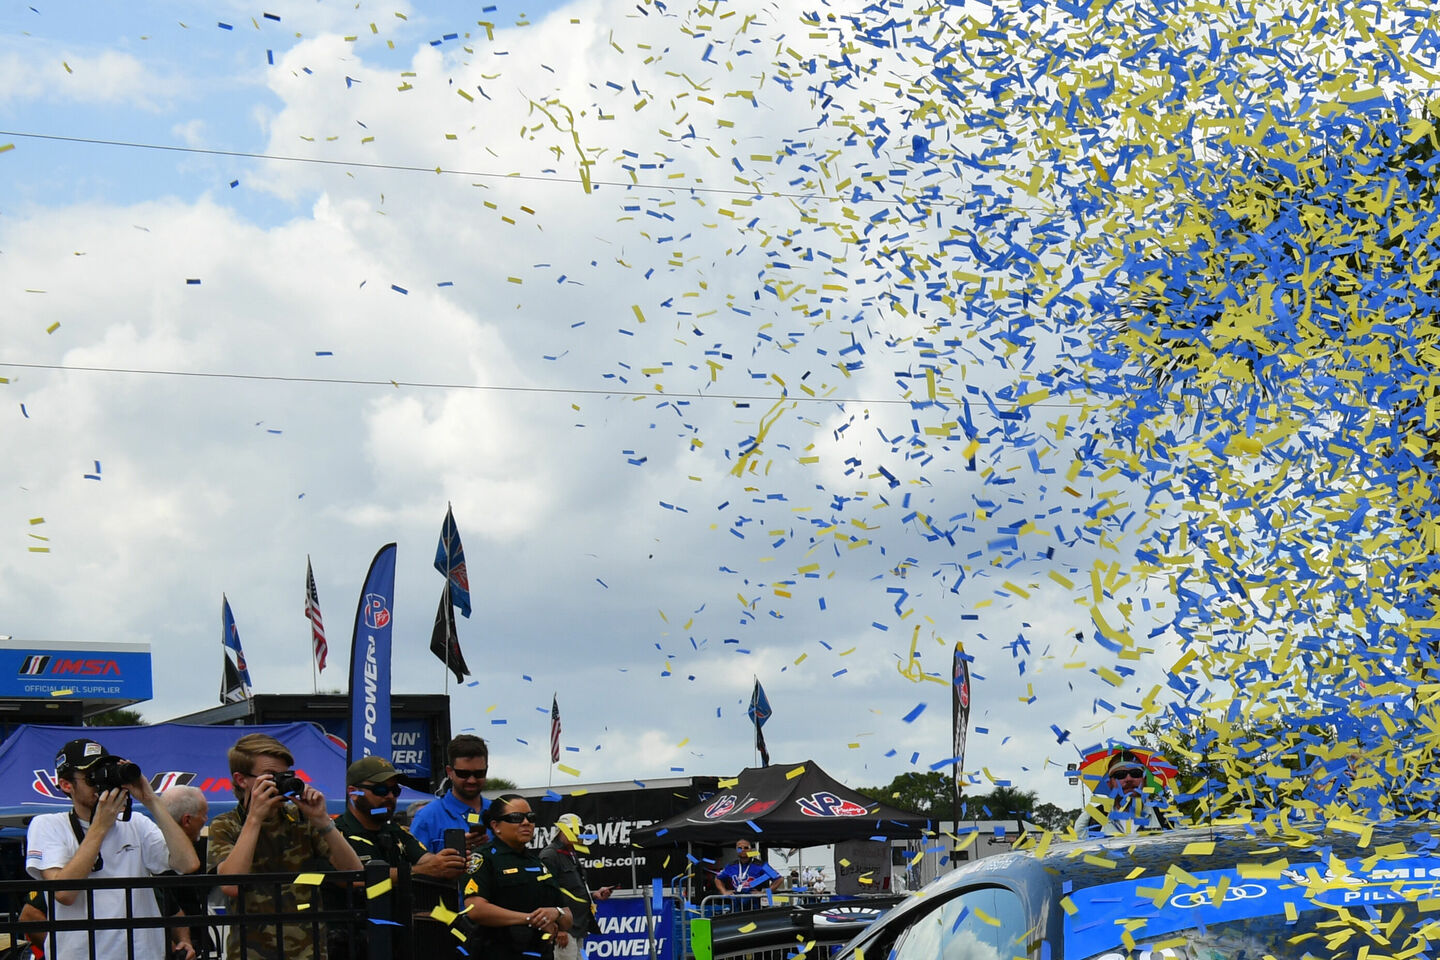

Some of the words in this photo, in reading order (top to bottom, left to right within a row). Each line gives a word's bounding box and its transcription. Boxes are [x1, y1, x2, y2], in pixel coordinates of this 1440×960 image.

[51, 659, 121, 675] IMSA
[25, 685, 58, 693] OFFICIAL
[83, 686, 120, 694] SUPPLIER
[364, 635, 379, 744] POWER!
[797, 792, 842, 817] VP
[598, 916, 662, 935] MAKIN'
[586, 938, 666, 957] POWER!
